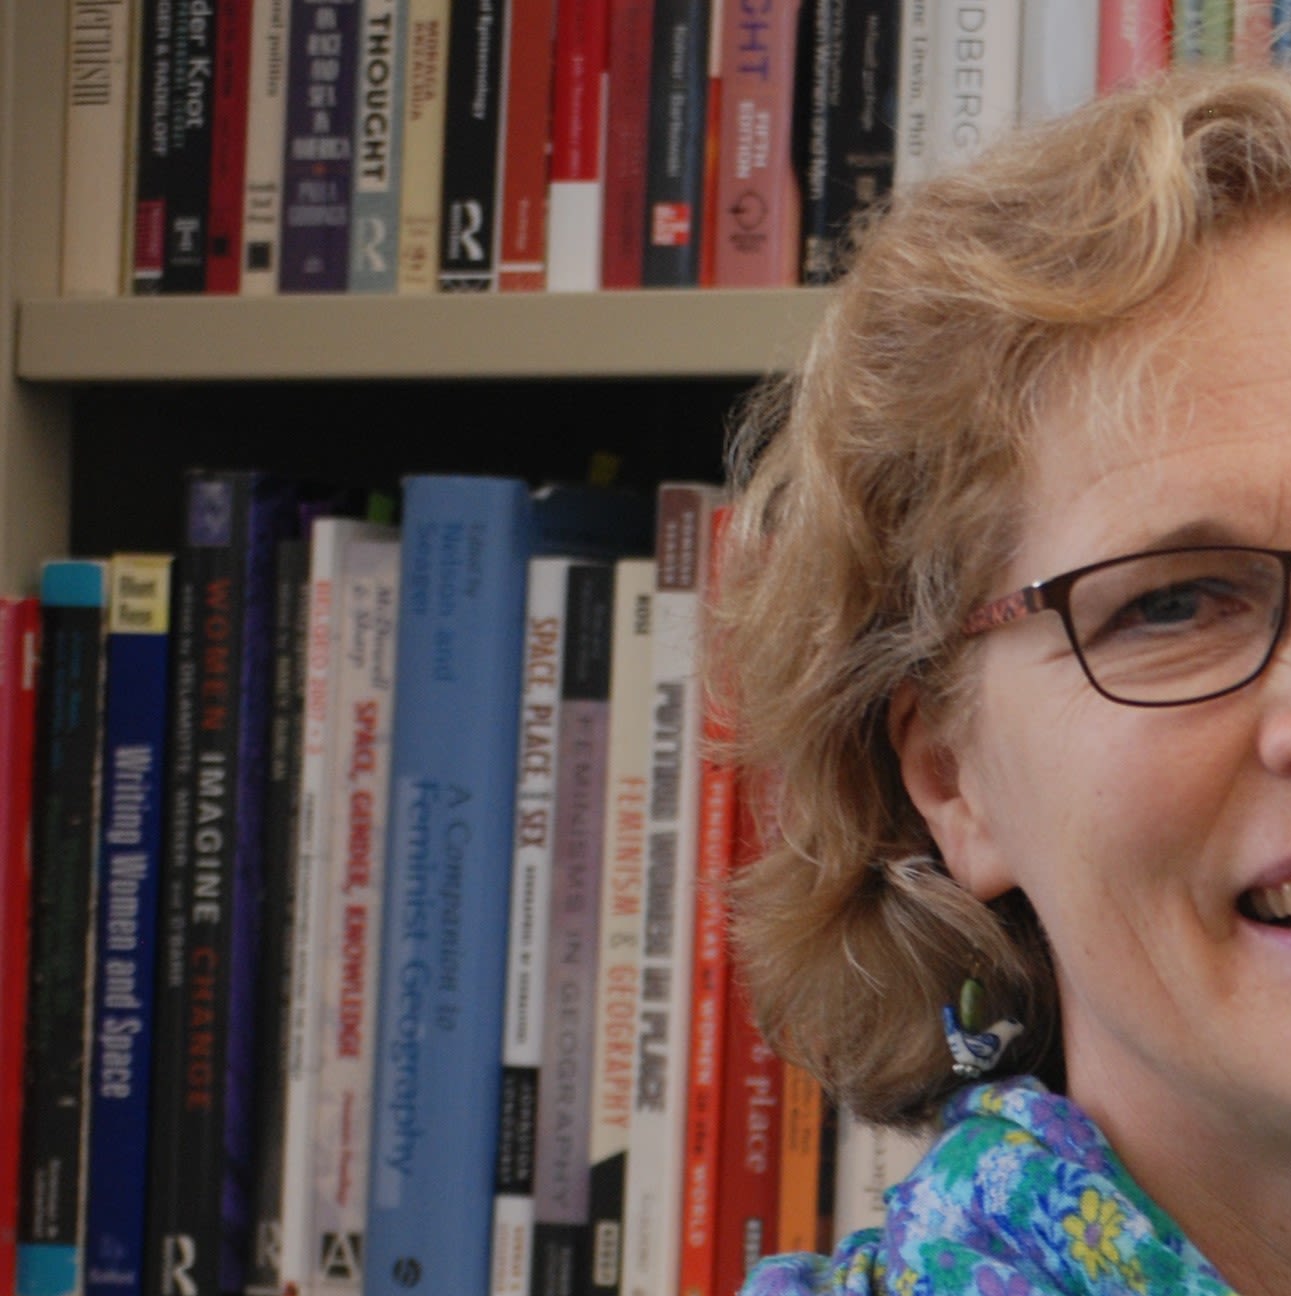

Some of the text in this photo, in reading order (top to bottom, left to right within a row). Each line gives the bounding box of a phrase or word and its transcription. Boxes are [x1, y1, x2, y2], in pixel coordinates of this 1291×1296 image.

[186, 59, 211, 129] Knot
[362, 12, 391, 182] THOUGHT
[185, 578, 233, 1113] WOMEN IMAGINE CHANGE
[341, 791, 376, 894] GENDER,
[519, 809, 546, 850] SEX
[101, 746, 154, 1098] Writing Women and Space
[337, 906, 368, 1060] KNOWLEDGE
[603, 777, 642, 1128] FEMINISM & GEOGRAPHY
